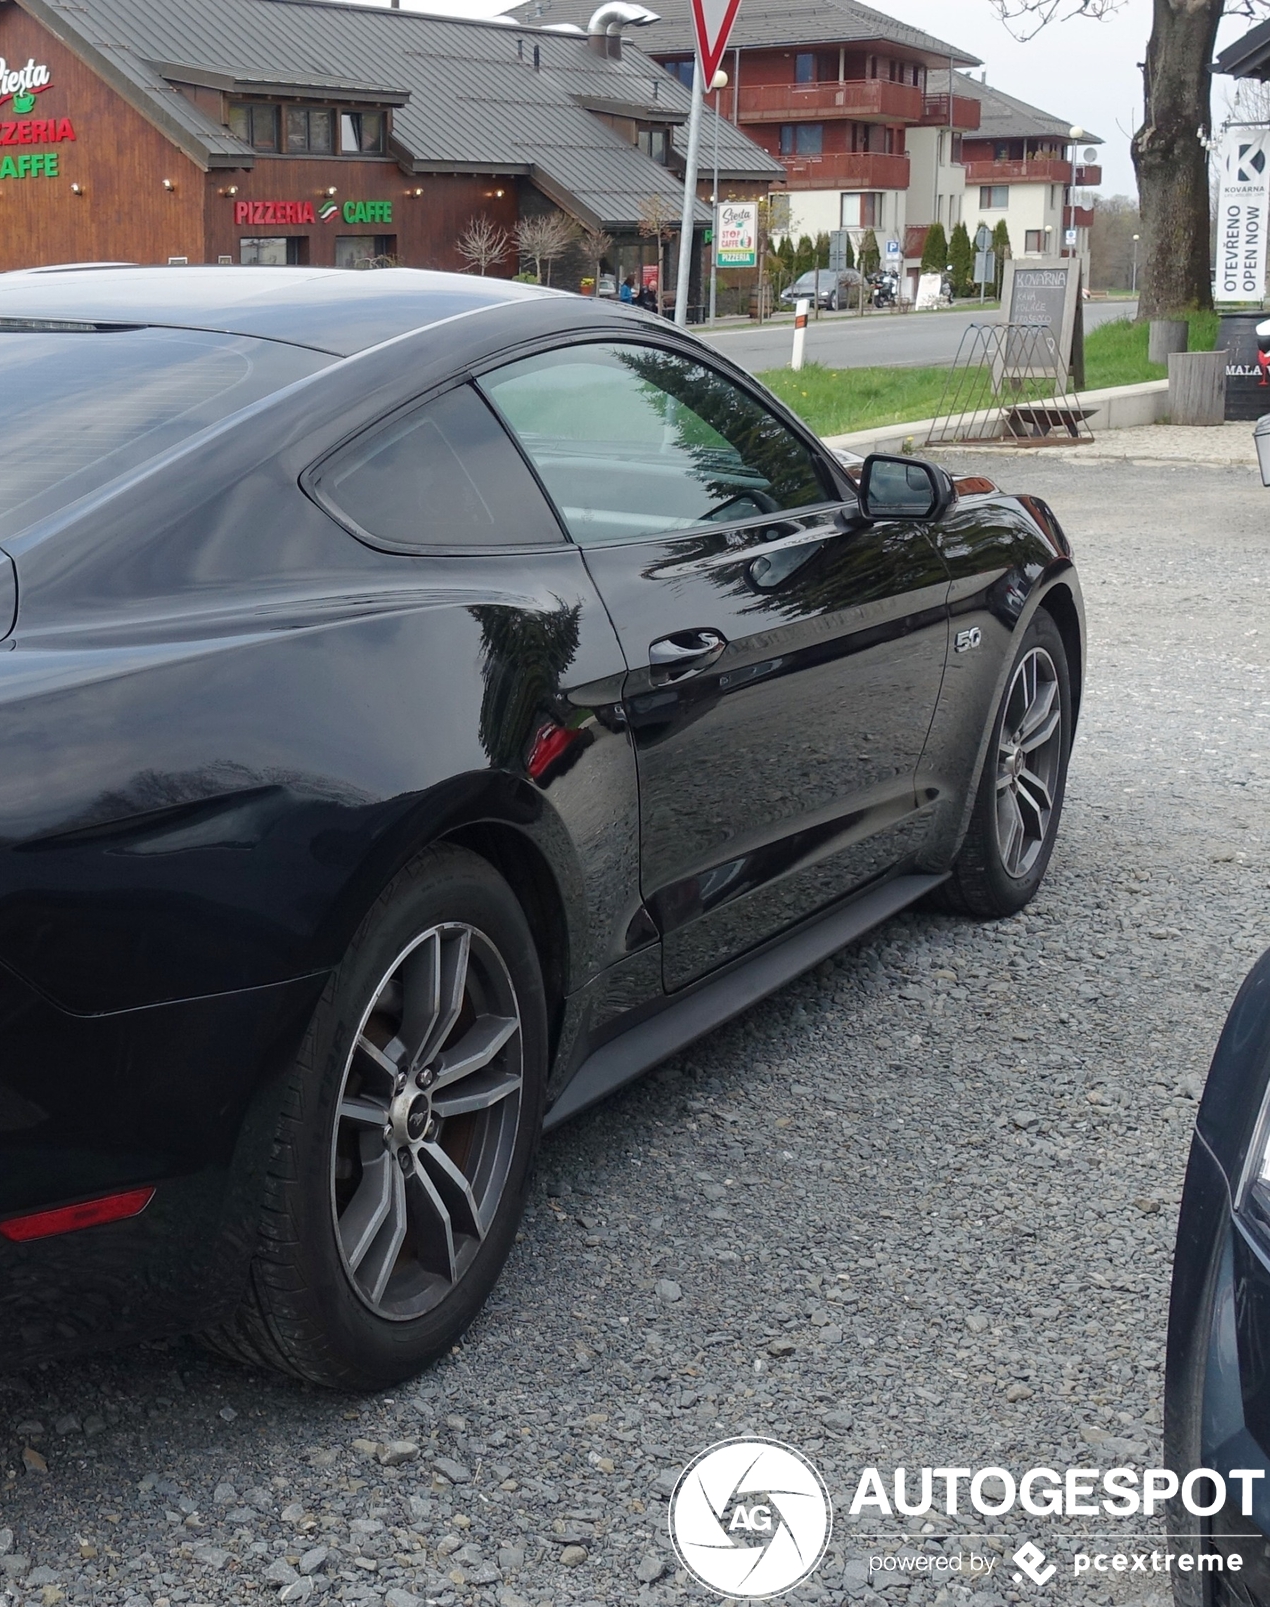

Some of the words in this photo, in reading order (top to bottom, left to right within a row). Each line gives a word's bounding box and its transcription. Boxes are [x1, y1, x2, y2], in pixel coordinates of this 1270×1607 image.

[235, 201, 315, 225] PIZZERIA
[343, 201, 393, 224] CAFFE
[722, 207, 751, 224] Siesta
[1245, 206, 1260, 245] NOW
[722, 230, 741, 239] STOP
[721, 239, 739, 248] CAFFE
[890, 243, 897, 252] P
[1223, 205, 1241, 292] OTEVŘENO
[722, 253, 751, 262] PIZZERIA
[1243, 249, 1258, 292] OPEN
